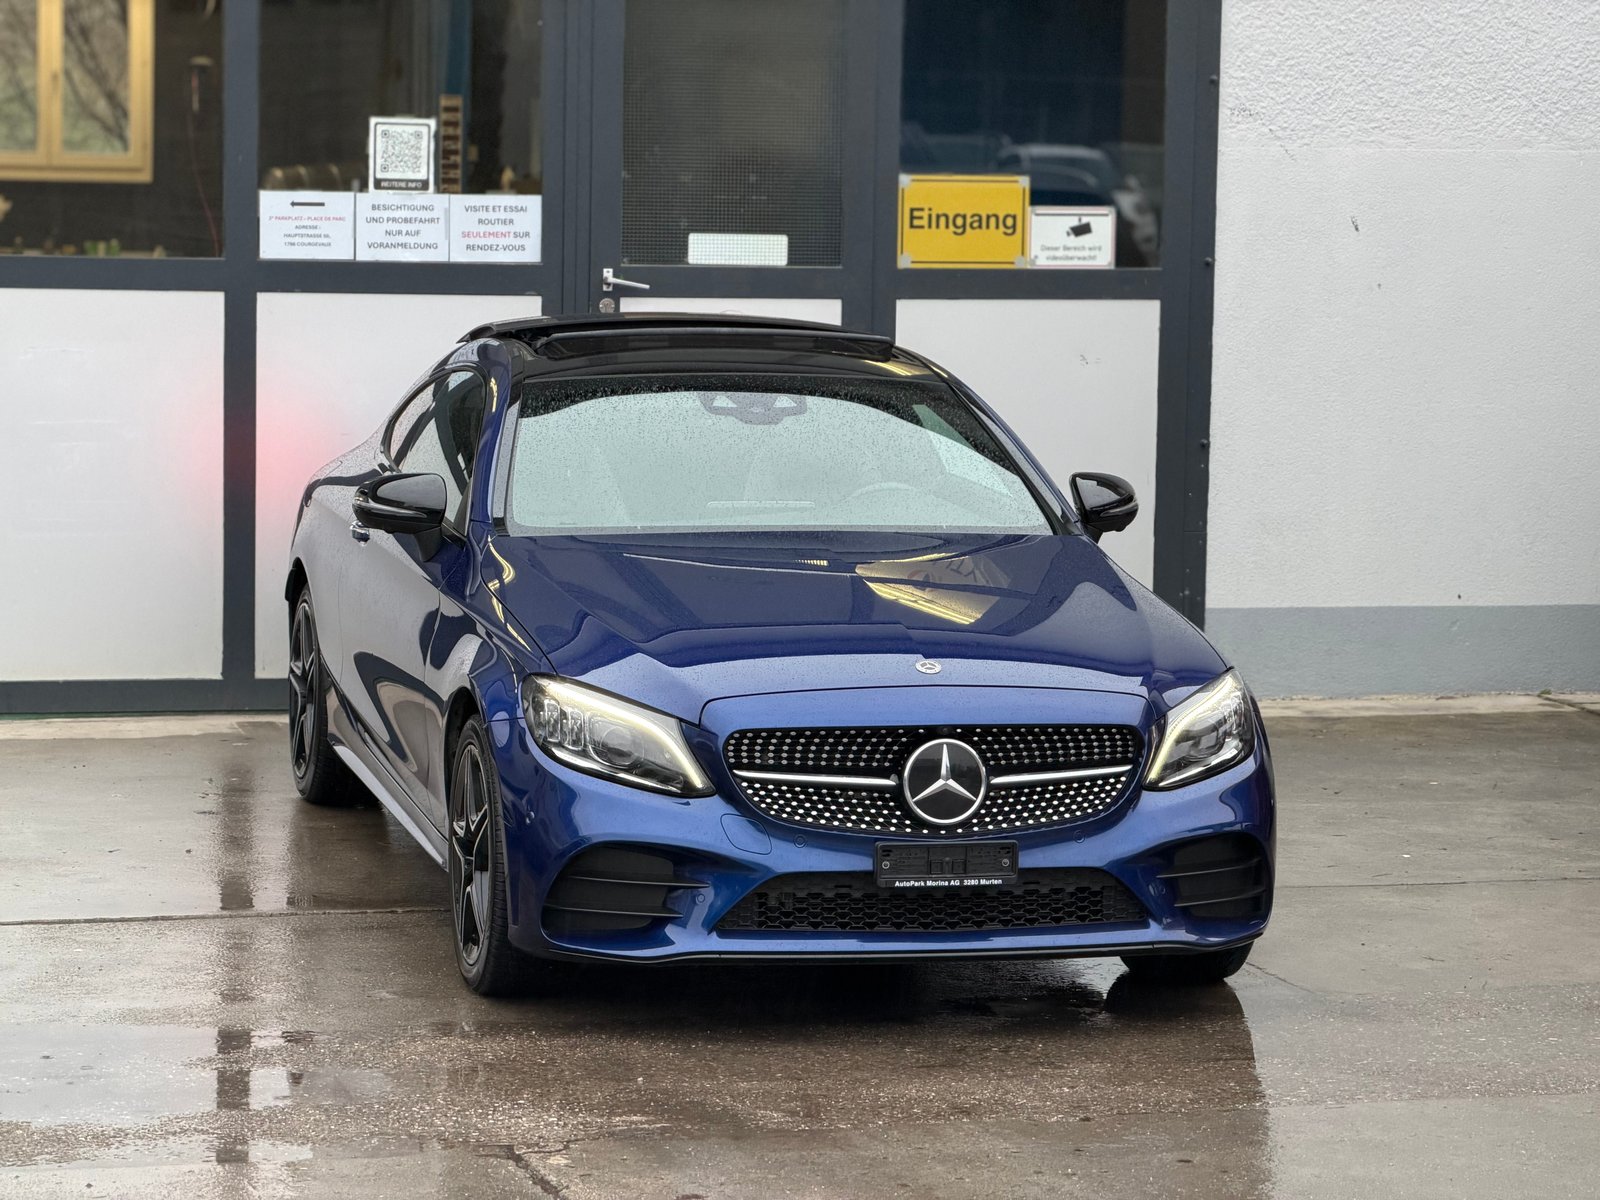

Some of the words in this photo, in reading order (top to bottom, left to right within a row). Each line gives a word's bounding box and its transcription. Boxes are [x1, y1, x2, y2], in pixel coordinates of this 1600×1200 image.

[371, 203, 435, 212] BESICHTIGUNG
[464, 205, 490, 213] VISITE
[492, 205, 502, 213] ET
[503, 205, 528, 213] ESSAI
[365, 216, 385, 224] UND
[386, 216, 441, 225] PROBEFAHRT
[477, 218, 515, 226] ROUTIER
[908, 207, 1017, 236] Eingang
[384, 229, 404, 237] NUR
[404, 229, 422, 237] AUF
[461, 231, 512, 239] SEULEMENT
[512, 231, 531, 239] SUR
[367, 241, 439, 250] VORANMELDUNG
[465, 244, 526, 252] RENDEZ-VOUS
[926, 879, 949, 887] Morina
